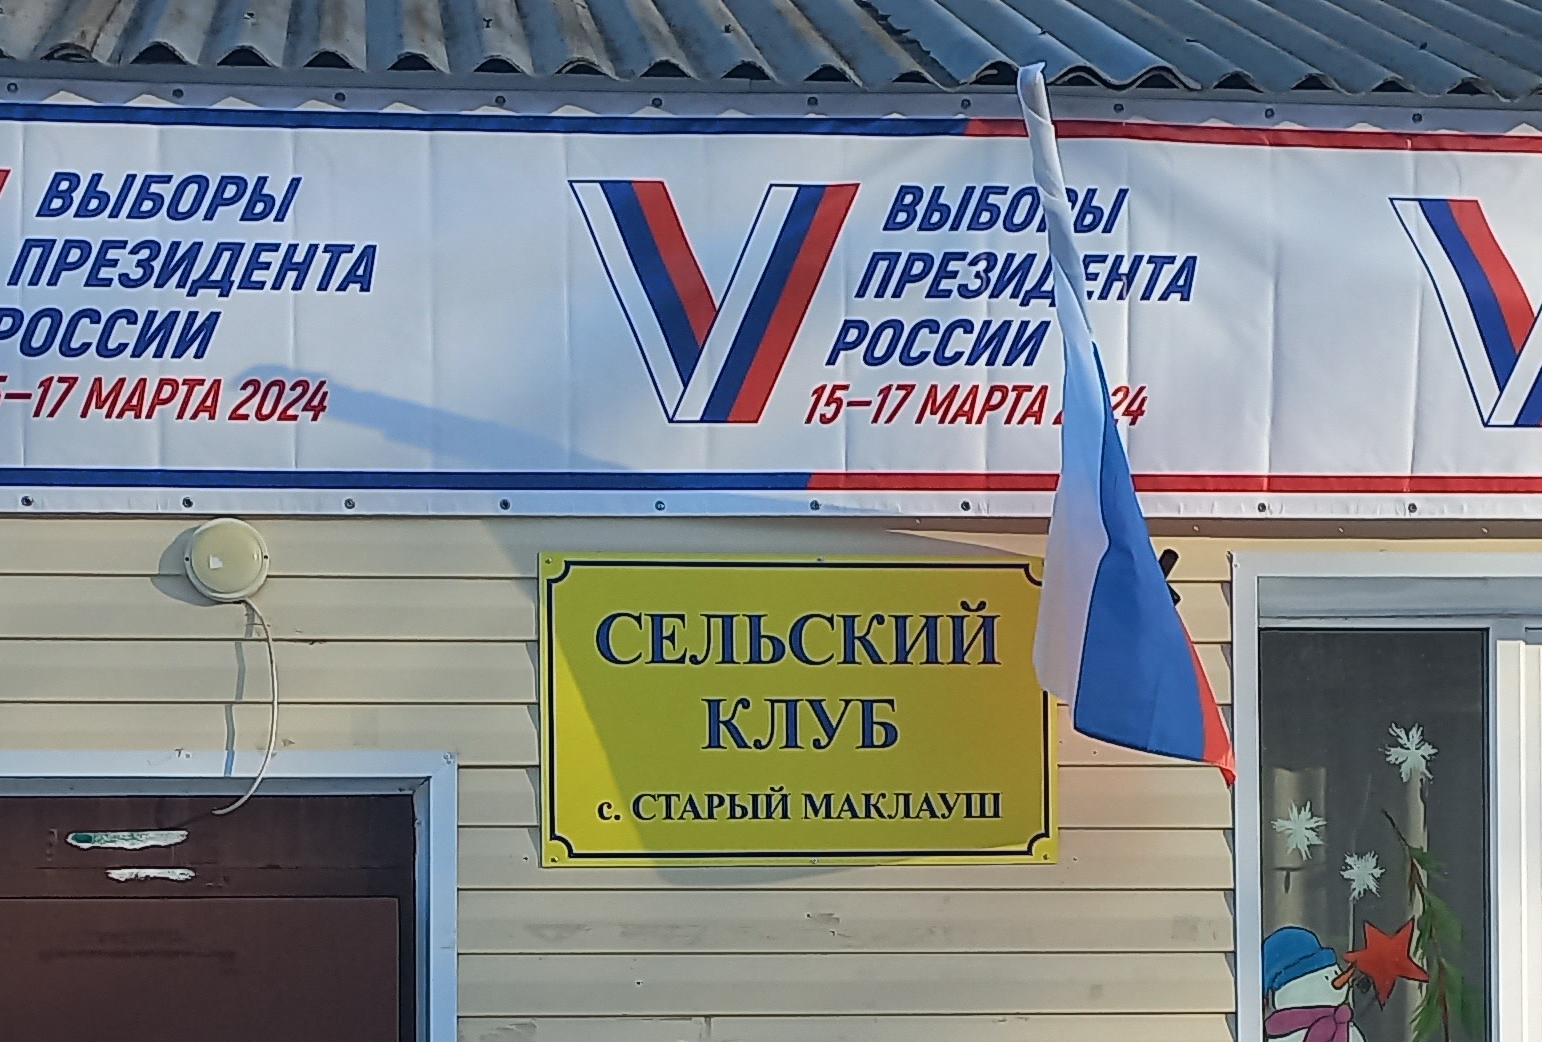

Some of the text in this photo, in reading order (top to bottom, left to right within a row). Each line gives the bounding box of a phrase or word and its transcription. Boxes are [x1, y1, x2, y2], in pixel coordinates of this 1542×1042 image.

[36, 172, 301, 223] ВЫБОРЫ
[7, 239, 375, 297] ПРЕЗИДЕНТА
[825, 320, 1050, 366] РОССИИ
[82, 379, 221, 421] МАРТА
[228, 378, 329, 422] 2024
[915, 386, 1050, 426] МАРТА
[595, 600, 1002, 666] СЕЛЬСКИЙ
[701, 698, 898, 750] КЛУБ
[597, 786, 1003, 821] с. СТАРЫЙ МАКЛАУШ
